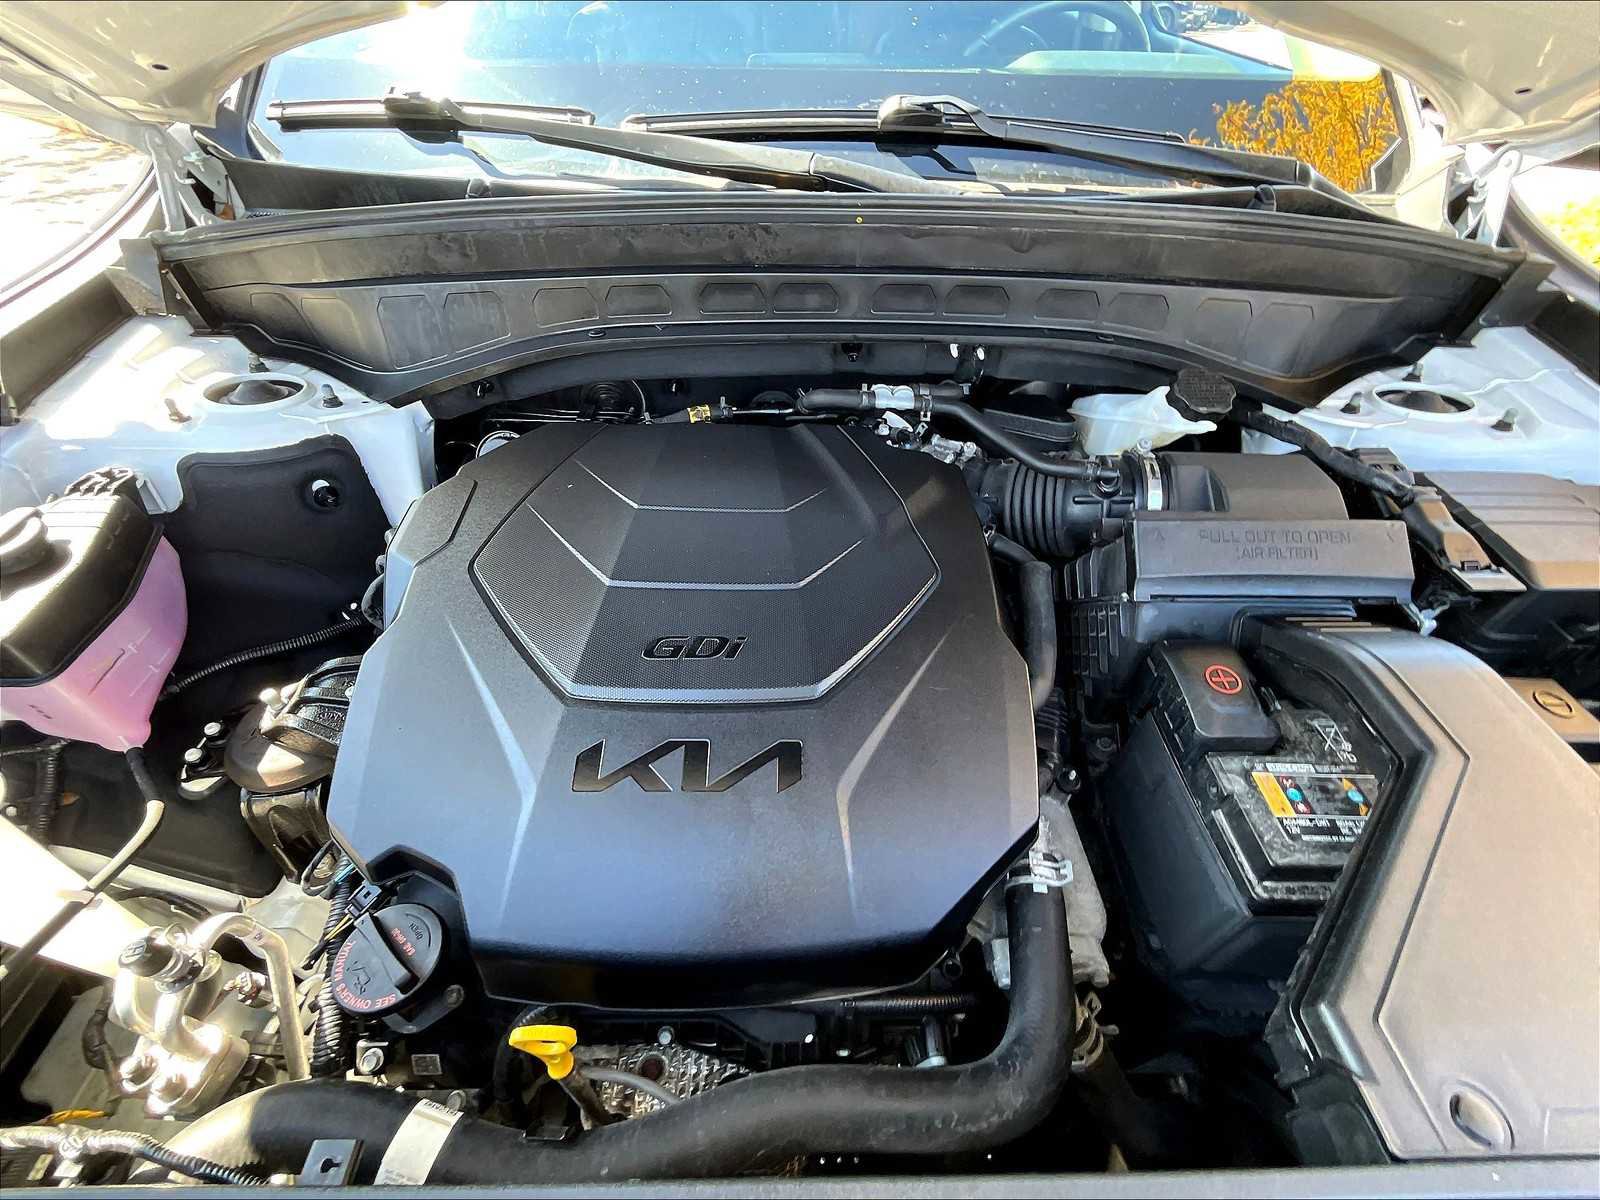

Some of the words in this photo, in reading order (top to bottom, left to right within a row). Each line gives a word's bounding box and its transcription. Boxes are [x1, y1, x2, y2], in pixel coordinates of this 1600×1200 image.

[1199, 529, 1239, 545] PULL
[1246, 529, 1278, 545] OUT
[1282, 529, 1304, 545] TO
[1307, 529, 1352, 545] OPEN
[375, 994, 396, 1008] SEE
